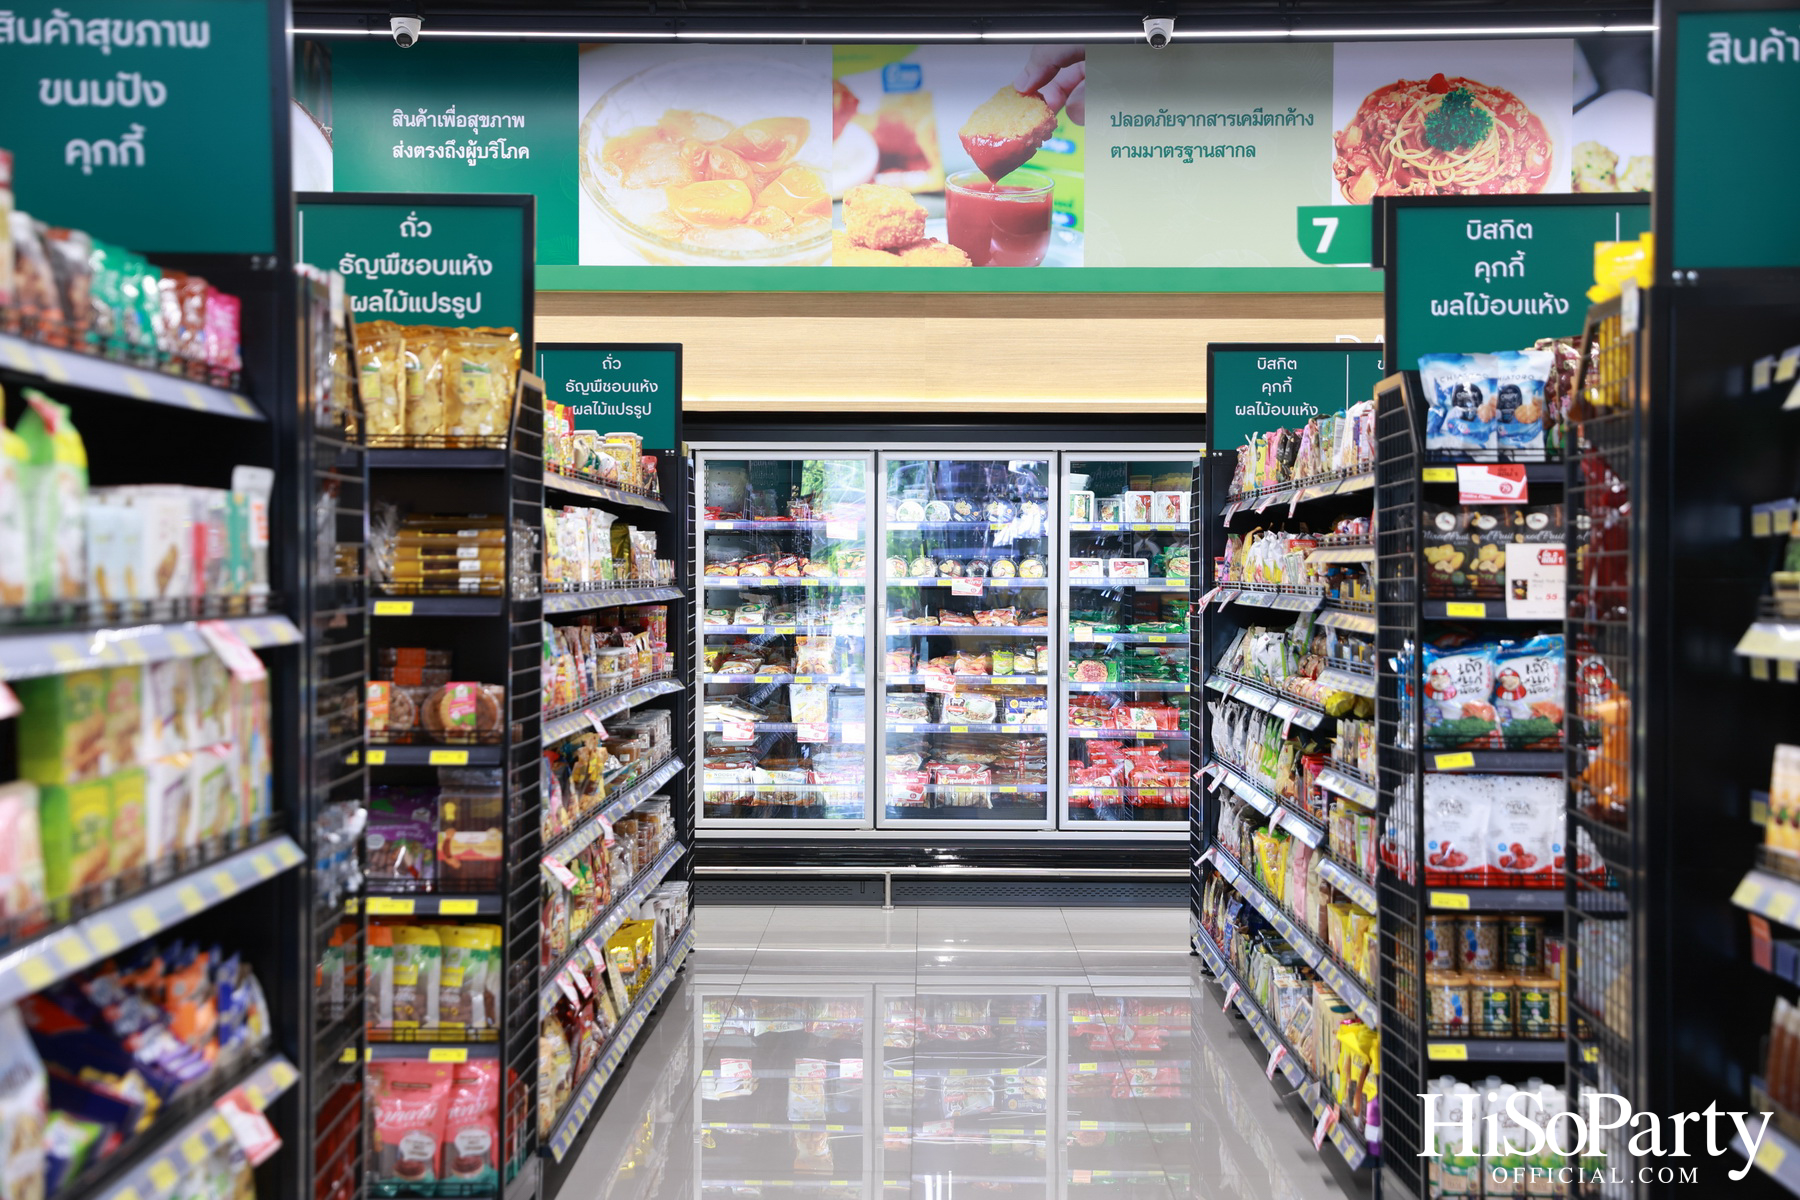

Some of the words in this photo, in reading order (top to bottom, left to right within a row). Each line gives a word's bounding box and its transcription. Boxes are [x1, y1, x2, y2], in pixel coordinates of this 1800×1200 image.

[39, 71, 167, 107] ขนมปัง
[391, 104, 525, 135] สินค้าเพื่อสุขภาพ
[1110, 107, 1314, 127] ปลอดภัยจากสารเคมีตกค้าง
[65, 123, 146, 175] คุกกี้
[392, 138, 530, 167] ส่งตรงถึงผู้บริโภค
[1110, 144, 1256, 164] ตามมาตรฐานสากล
[399, 211, 432, 238] ถั่ว
[1312, 217, 1339, 253] 7
[1466, 219, 1533, 240] บิสกิต
[338, 252, 493, 280] ธัญพืชอบแห้ง
[1474, 250, 1526, 284] คุกกี้
[350, 289, 482, 319] ผลไม้แปรรูป
[1430, 292, 1570, 316] ผลไม้อบแห้ง
[602, 353, 622, 370] ถั่ว
[1257, 357, 1298, 370] บิสกิต
[565, 379, 659, 395] ธัญพืชอบแห้ง
[1261, 376, 1293, 396] คุกกี้
[571, 401, 652, 419] ผลไม้แปรรูป
[1235, 401, 1319, 416] ผลไม้อบแห้ง
